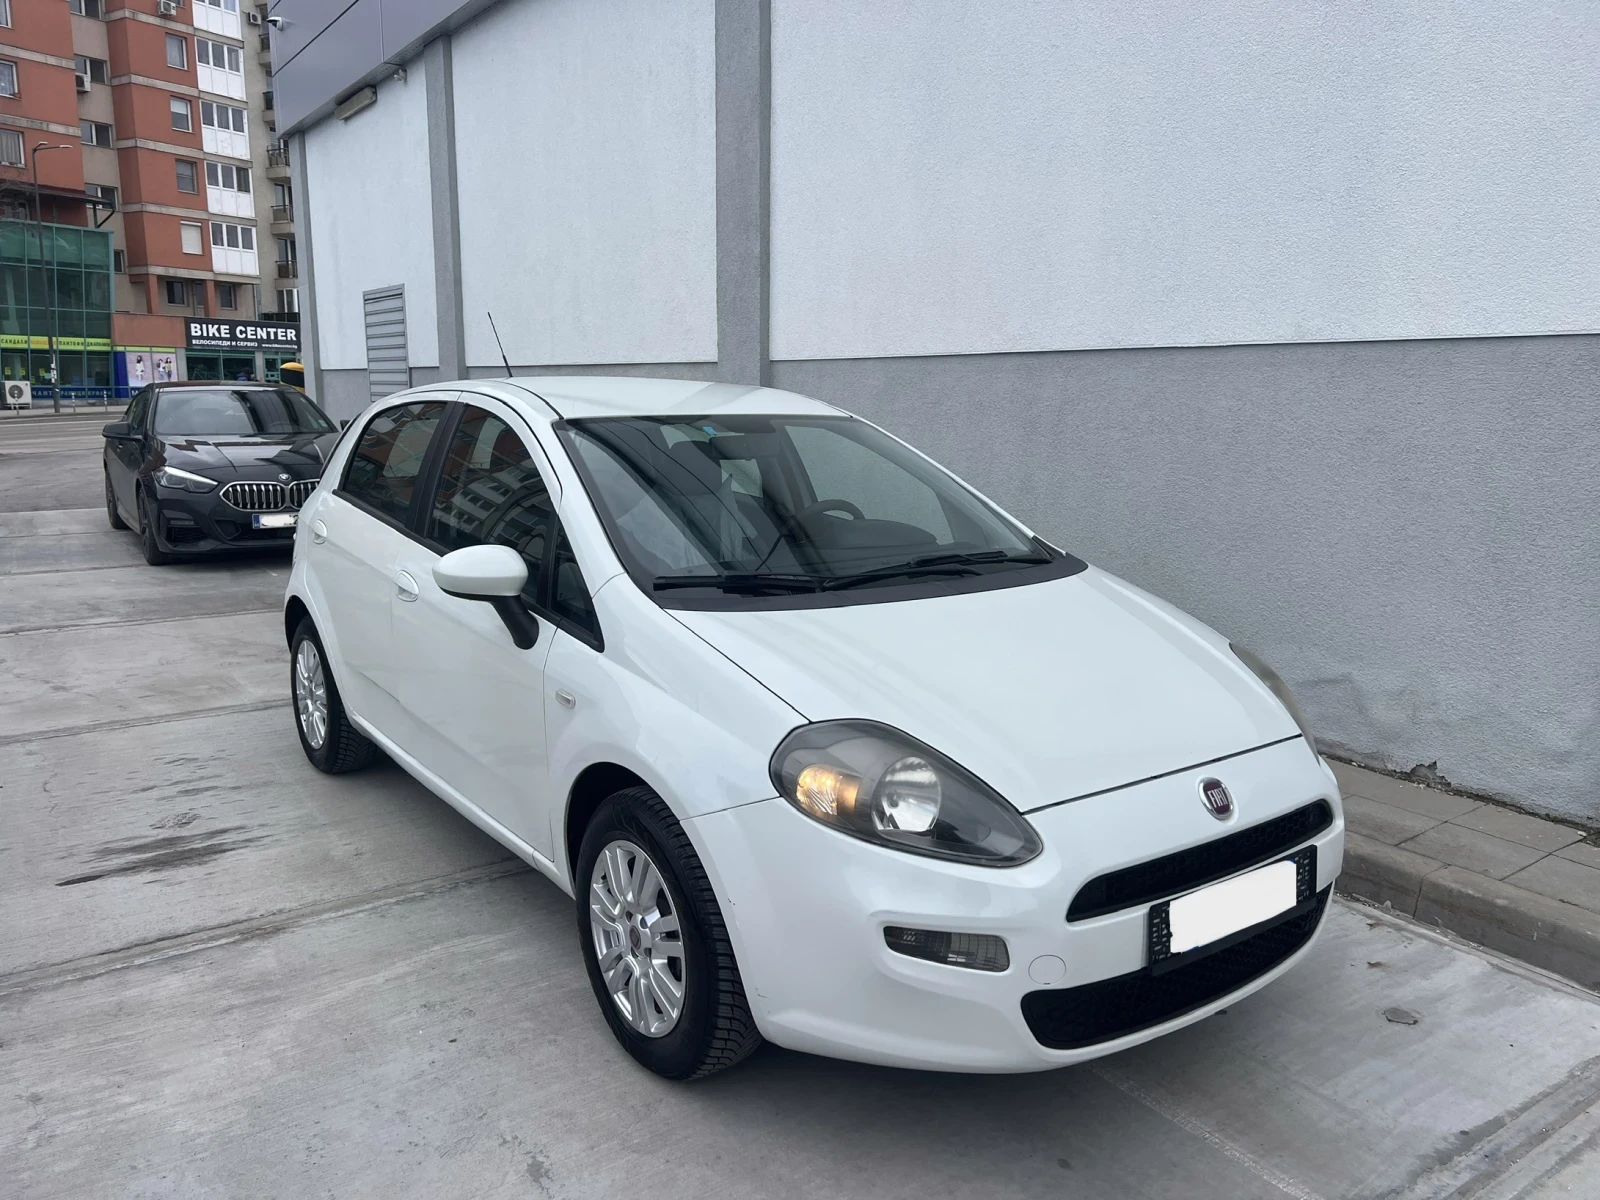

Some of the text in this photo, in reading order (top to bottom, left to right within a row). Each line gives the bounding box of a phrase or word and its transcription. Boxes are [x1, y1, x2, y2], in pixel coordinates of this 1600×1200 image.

[190, 323, 297, 341] BIKE CENTER
[1207, 787, 1228, 808] FIAT
